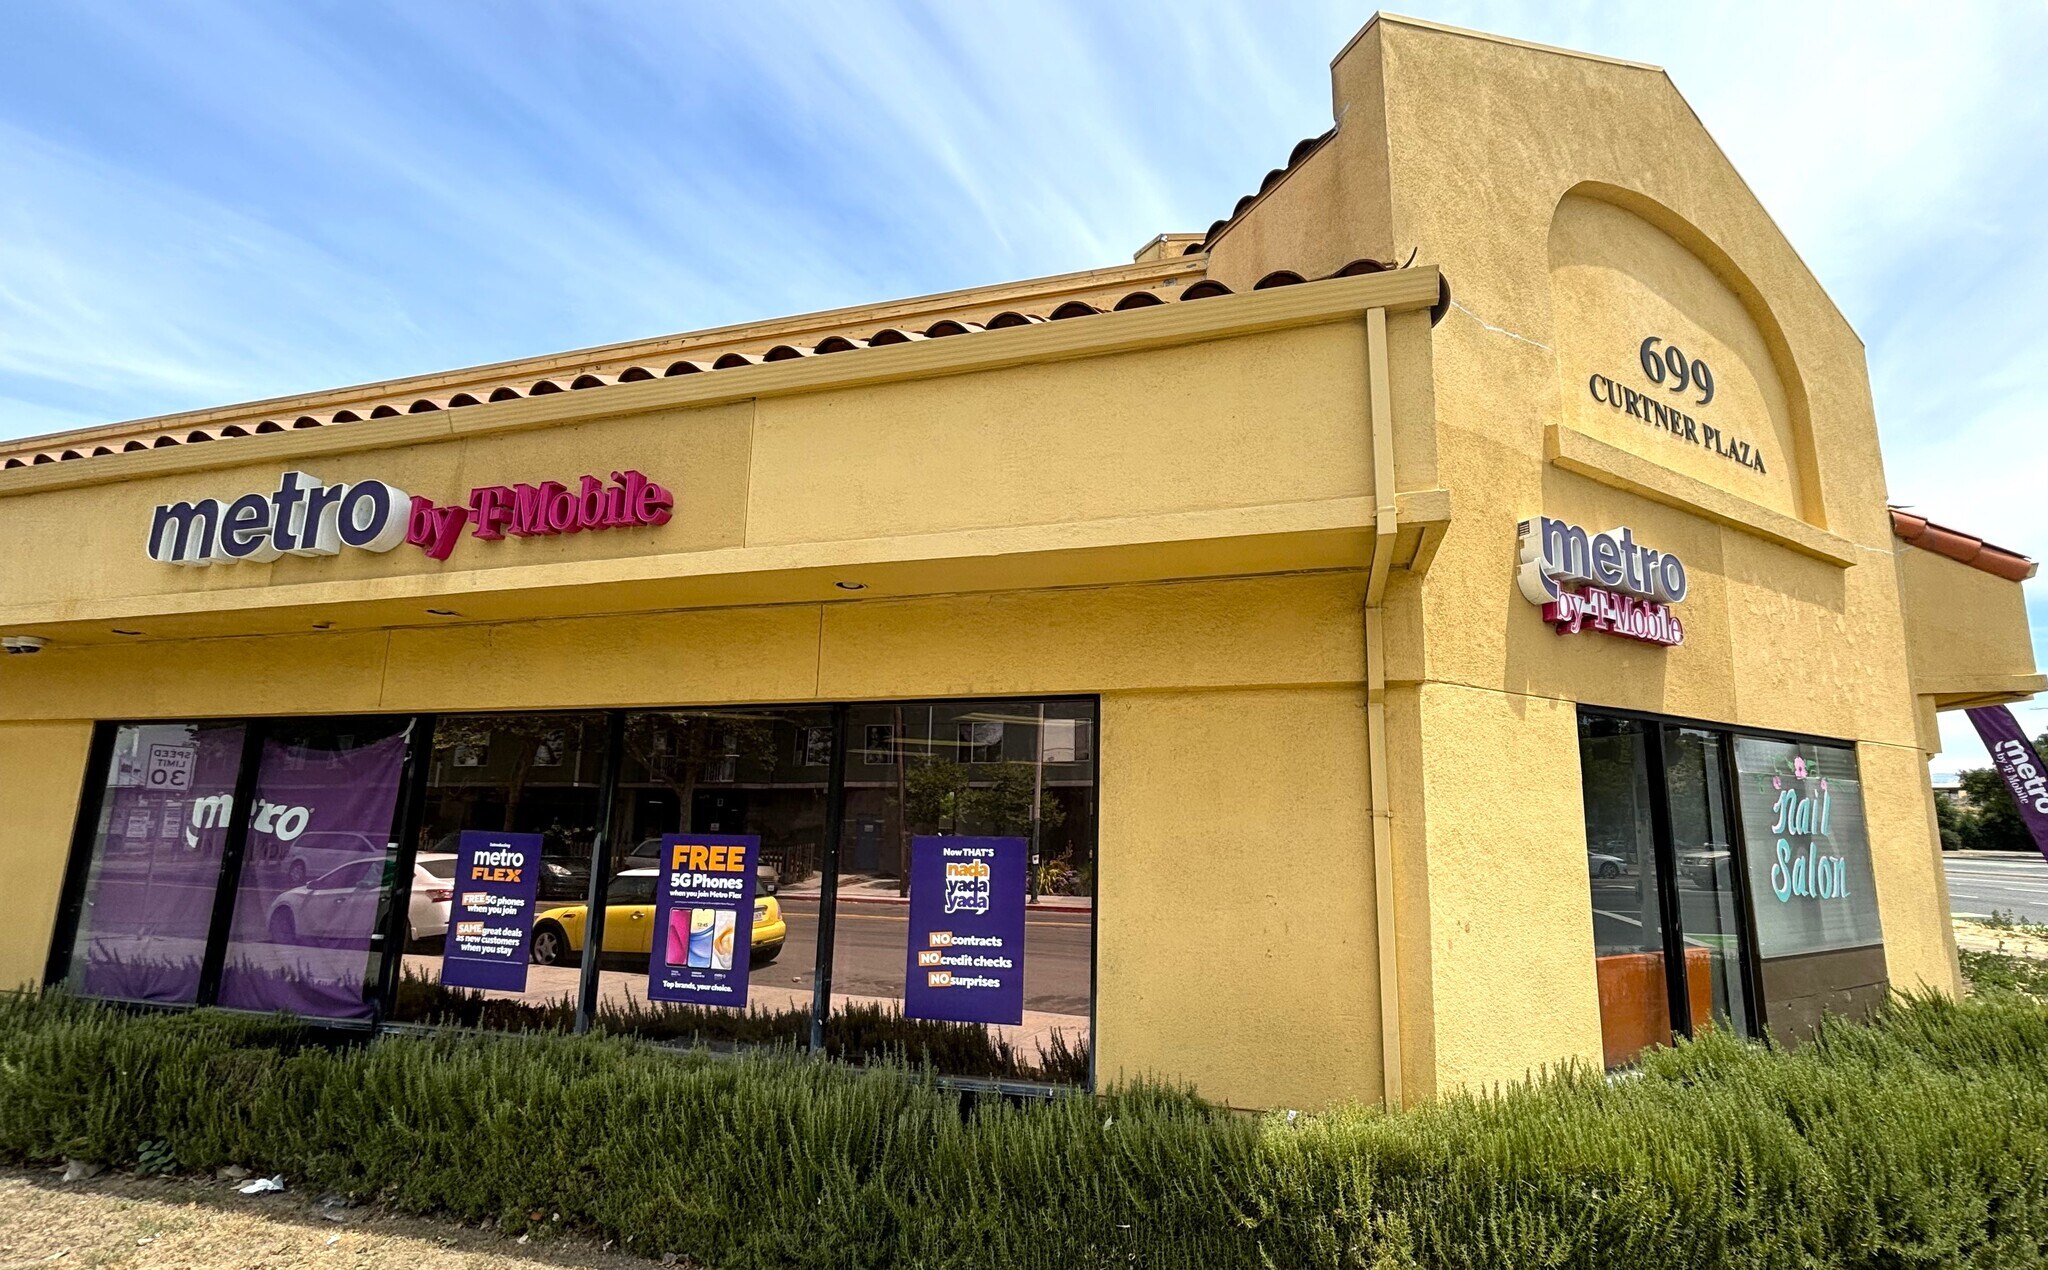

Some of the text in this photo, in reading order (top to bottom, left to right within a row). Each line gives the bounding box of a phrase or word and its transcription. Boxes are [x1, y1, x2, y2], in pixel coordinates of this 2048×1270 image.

[1640, 336, 1714, 405] 699
[1589, 373, 1767, 474] CURTNER PLAZA
[147, 471, 400, 564] metro
[406, 495, 468, 561] by
[1539, 516, 1688, 602] metro
[1556, 580, 1585, 634] by
[2002, 739, 2048, 815] metro
[191, 793, 310, 842] mtro
[473, 849, 525, 868] metro
[671, 845, 747, 872] FREE
[943, 848, 995, 857] Now THAT'S
[471, 867, 523, 883] FLEX
[947, 860, 989, 877] nada
[1771, 838, 1851, 903] Salon
[670, 872, 744, 890] 5G Phones
[947, 877, 988, 895] yada
[463, 893, 525, 907] FREE 5G phones
[685, 891, 697, 899] you
[697, 891, 709, 899] join
[709, 891, 728, 899] Metro
[945, 893, 988, 912] yada
[467, 904, 518, 917] when you join
[458, 924, 523, 938] SAME great deals
[465, 936, 481, 944] new
[481, 937, 520, 947] customers
[931, 934, 1003, 947] NO contracts
[461, 943, 513, 957] when you stay
[920, 953, 1013, 968] NO credit checks
[662, 980, 733, 993] Top brands, your choice.
[930, 973, 1000, 989] NO surprises
